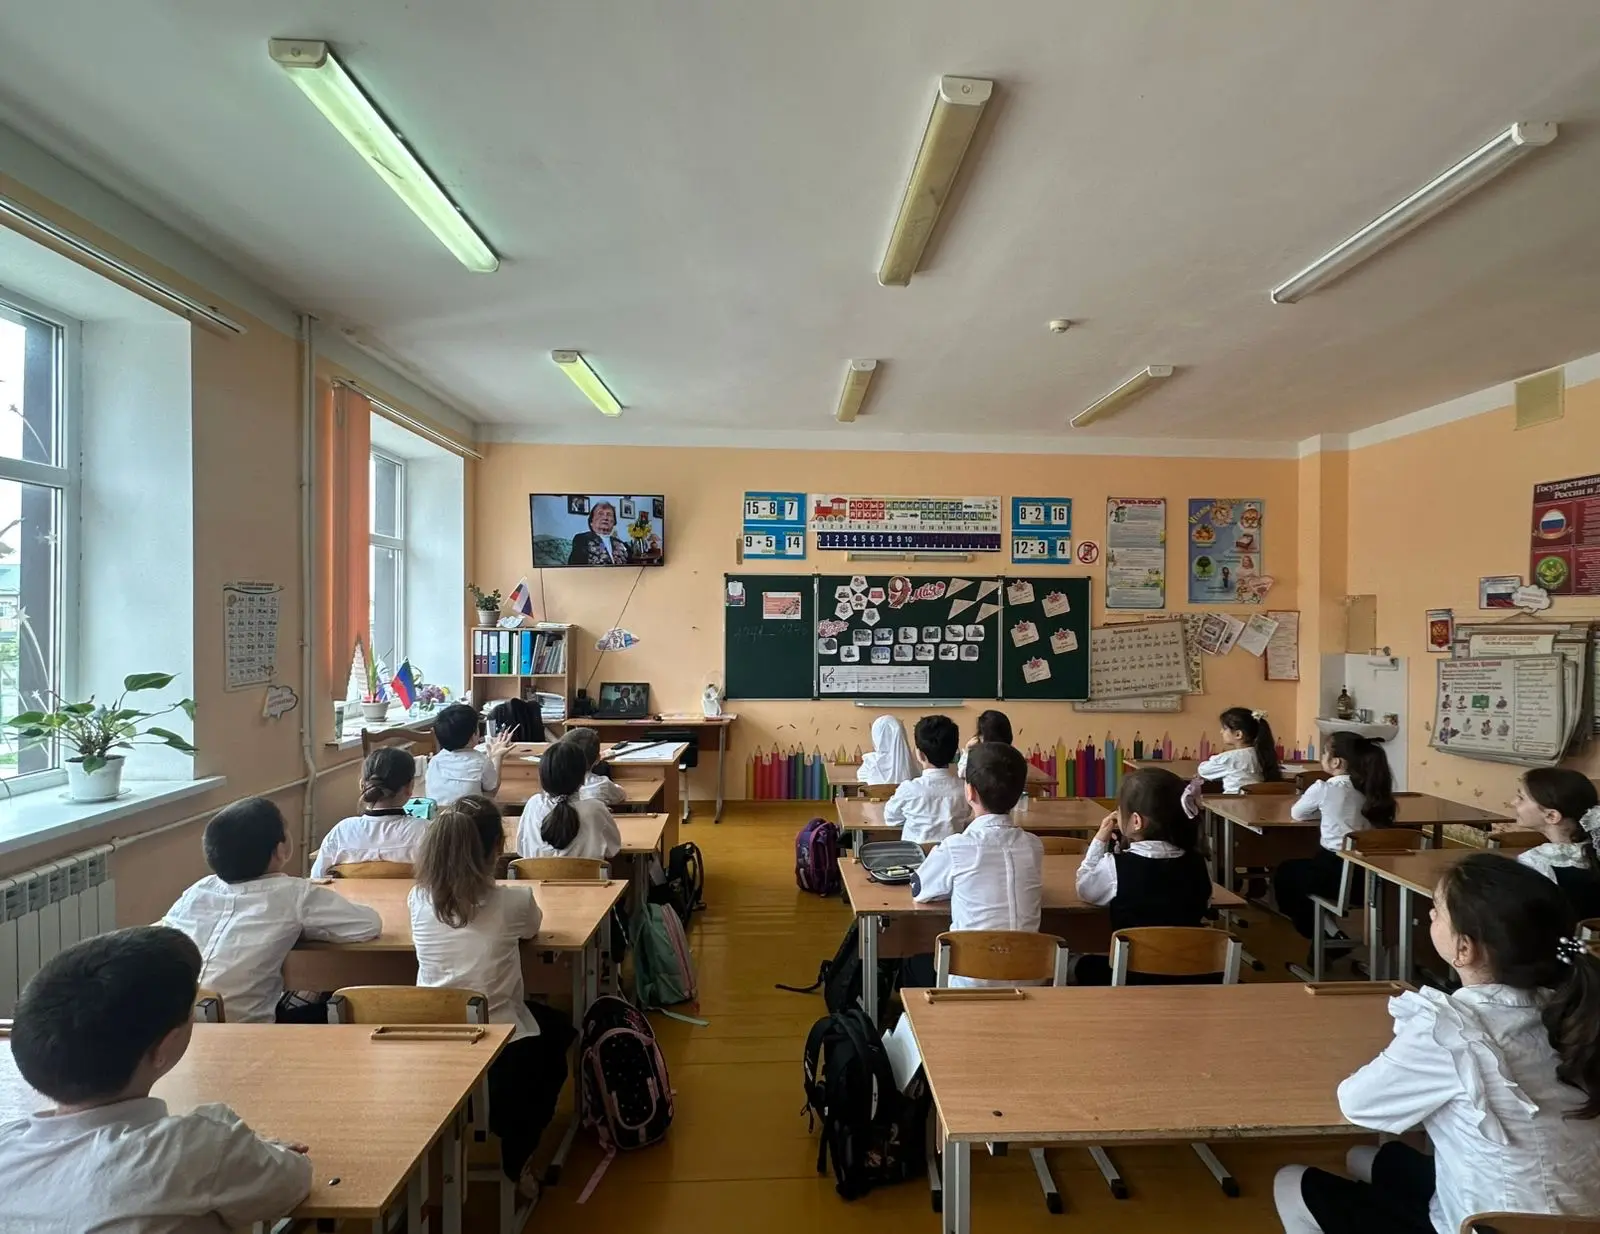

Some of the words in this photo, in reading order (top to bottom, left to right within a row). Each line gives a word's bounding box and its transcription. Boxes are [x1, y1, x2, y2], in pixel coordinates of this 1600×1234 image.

[1554, 489, 1585, 499] России
[746, 501, 759, 515] 15
[769, 501, 776, 515] 8
[788, 502, 795, 515] 7
[1020, 507, 1027, 520] 8
[1035, 507, 1042, 520] 2
[1053, 507, 1065, 521] 16
[745, 535, 753, 547] 9
[765, 536, 773, 548] 5
[787, 536, 800, 548] 14
[817, 534, 821, 542] 0
[826, 534, 830, 542] 1
[834, 534, 839, 542] 2
[843, 534, 848, 542] 3
[852, 534, 857, 542] 4
[861, 534, 866, 542] 5
[870, 534, 875, 542] 6
[879, 534, 884, 542] 7
[888, 534, 893, 542] 8
[896, 534, 901, 542] 9
[904, 535, 913, 543] 10
[1014, 541, 1028, 554] 12
[1038, 541, 1045, 554] 3
[1058, 541, 1066, 555] 4
[889, 576, 910, 608] 9
